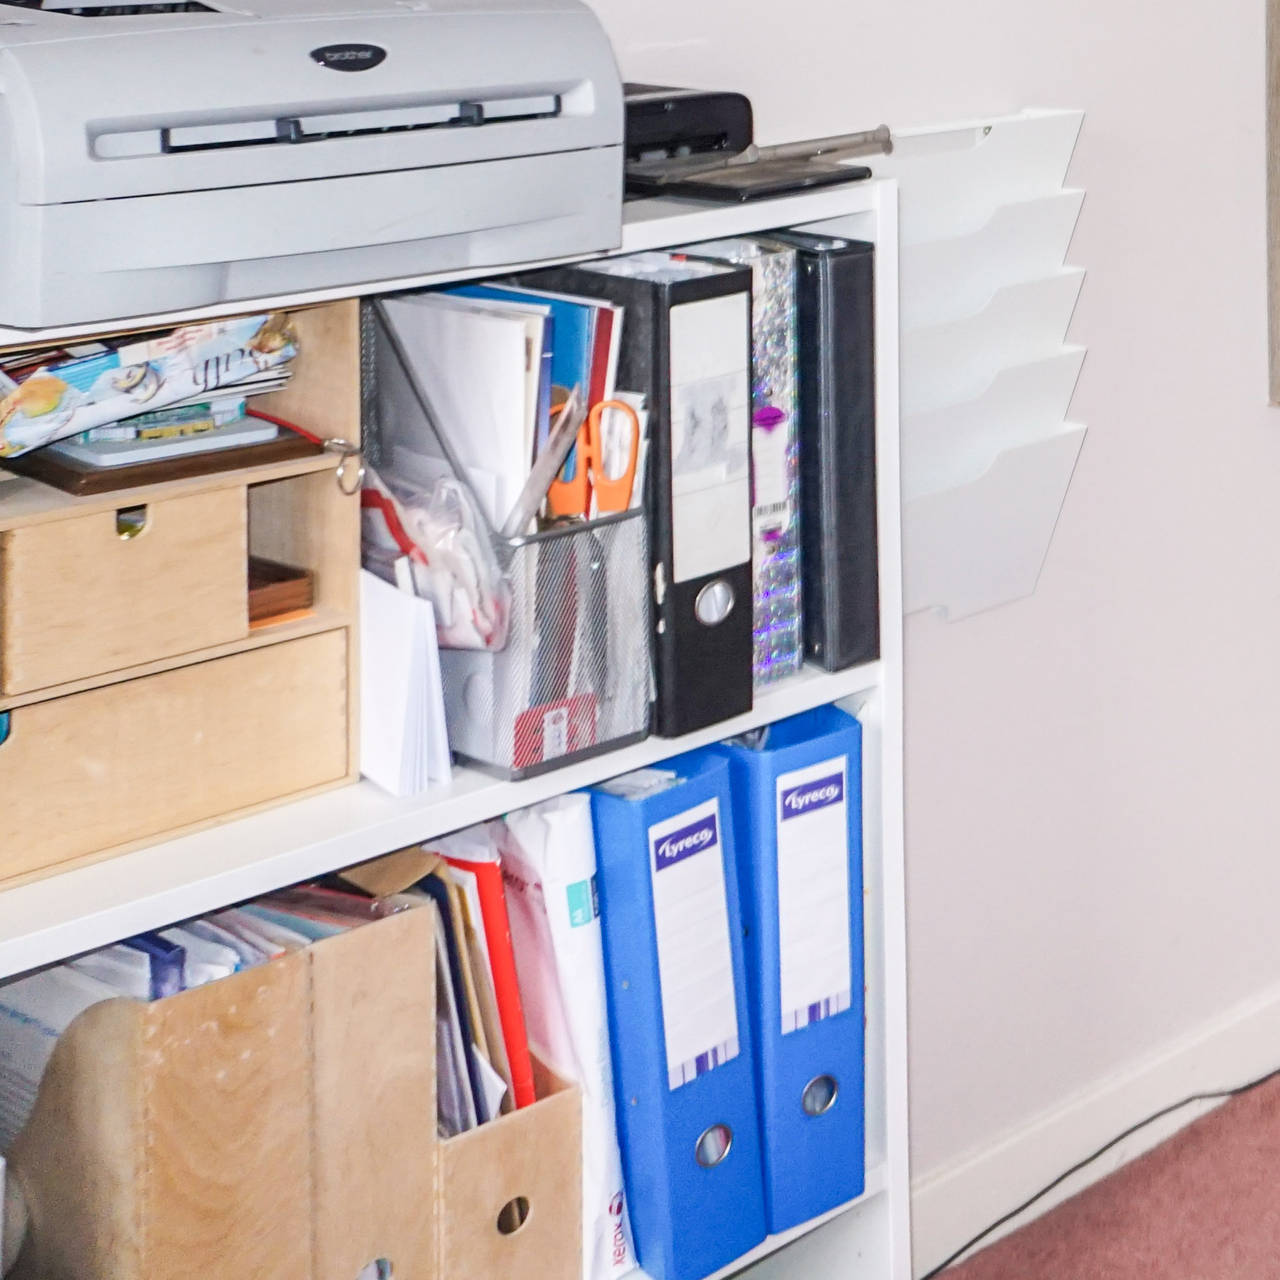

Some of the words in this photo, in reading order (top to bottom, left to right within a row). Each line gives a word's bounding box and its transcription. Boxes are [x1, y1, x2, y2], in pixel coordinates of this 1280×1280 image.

[324, 50, 372, 61] brother
[785, 783, 840, 810] Lyreco
[658, 827, 714, 858] Lyreco
[613, 1223, 626, 1267] xerox
